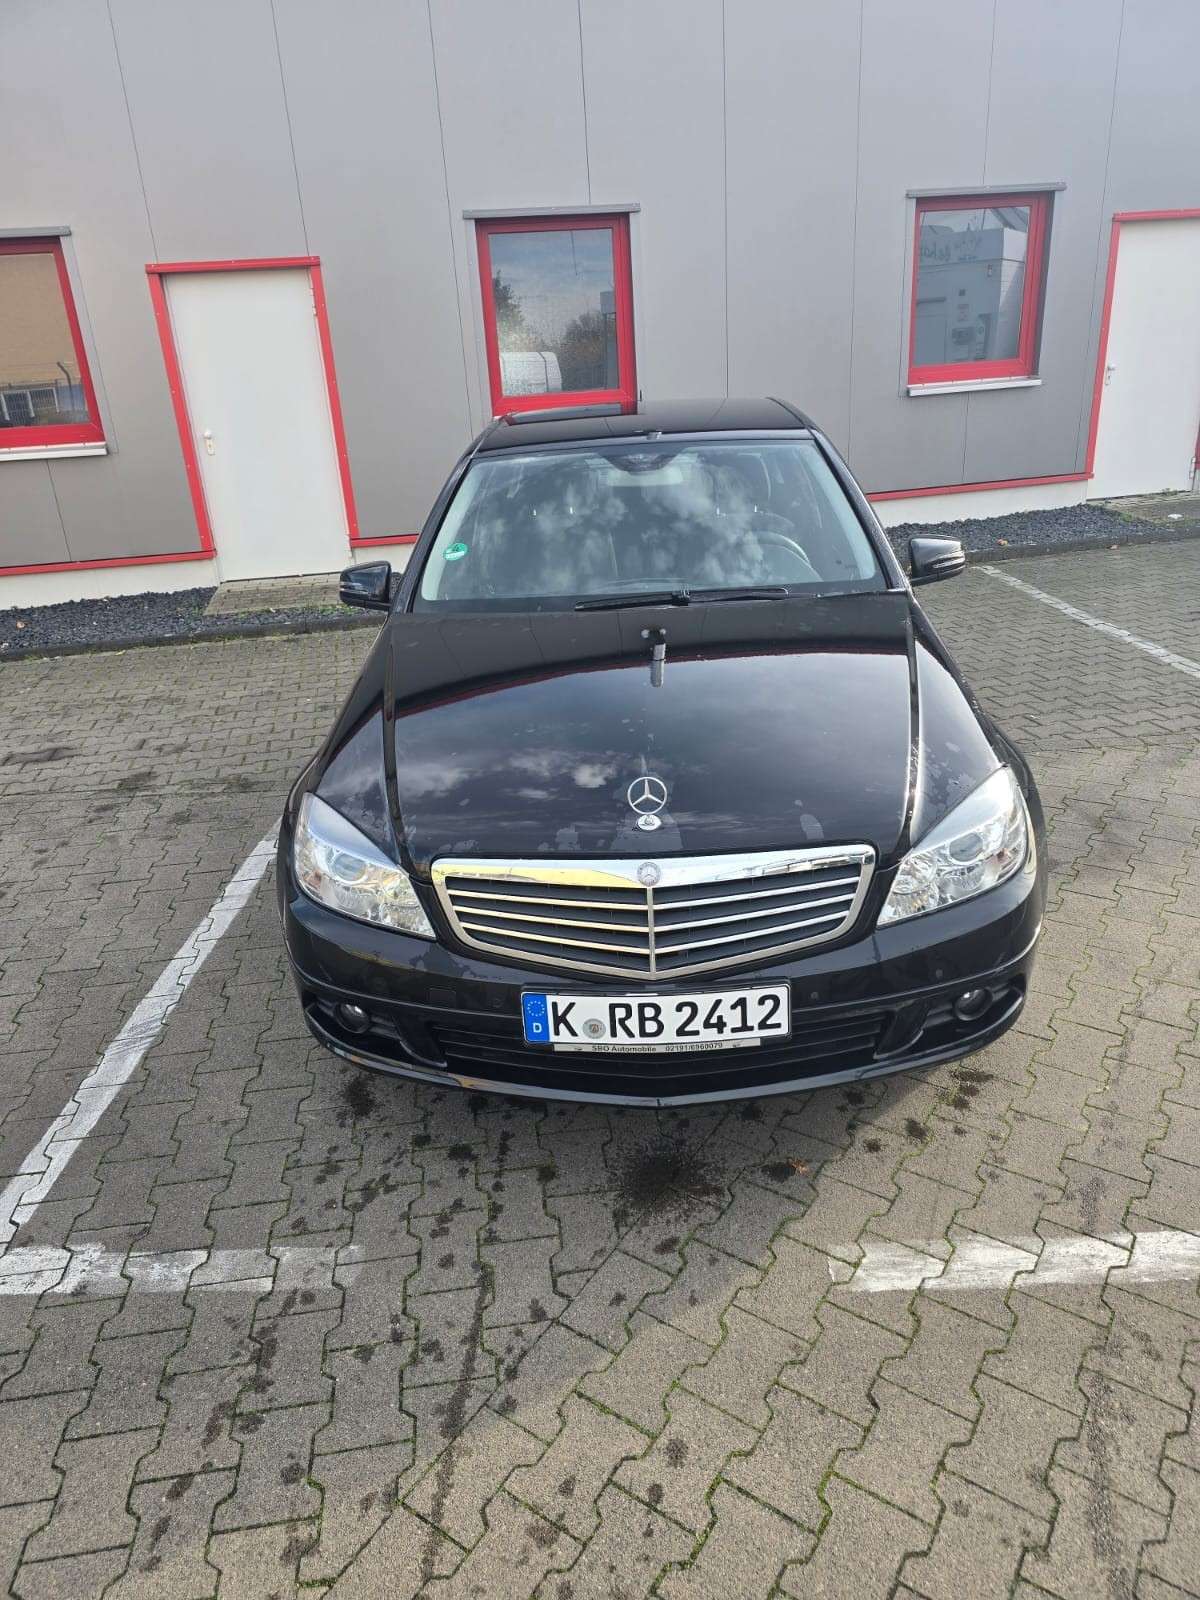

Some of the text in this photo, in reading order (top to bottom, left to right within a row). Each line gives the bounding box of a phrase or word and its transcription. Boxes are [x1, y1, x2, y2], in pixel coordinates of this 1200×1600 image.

[551, 994, 781, 1038] K RB 2412
[533, 1022, 542, 1033] D
[611, 1045, 657, 1053] Automobile
